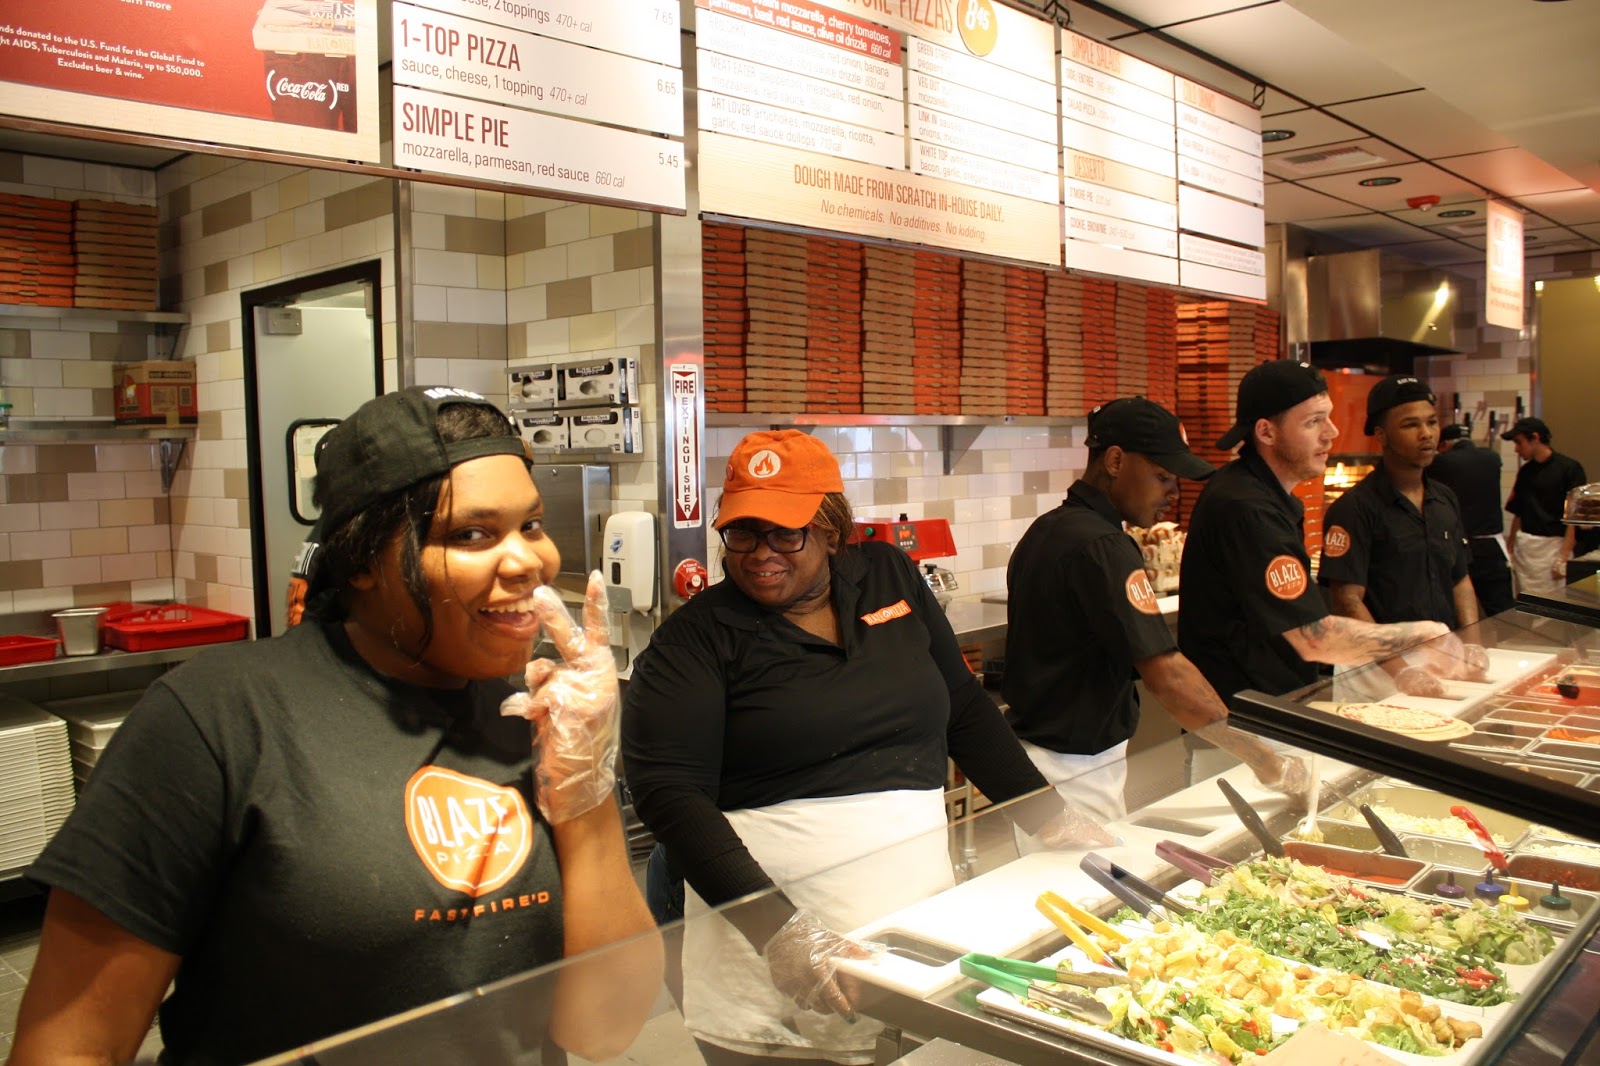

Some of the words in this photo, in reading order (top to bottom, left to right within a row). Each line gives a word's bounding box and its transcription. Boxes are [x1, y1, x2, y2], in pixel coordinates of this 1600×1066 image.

[145, 0, 172, 11] more
[503, 0, 551, 24] toppings
[555, 13, 579, 30] 470+
[580, 20, 593, 33] cal
[653, 8, 674, 26] 7.65
[754, 5, 776, 26] basil,
[776, 15, 791, 29] red
[791, 20, 817, 38] sauce,
[817, 27, 835, 41] olive
[835, 31, 845, 45] oil
[845, 35, 868, 51] drizzle
[870, 43, 883, 56] 660
[883, 48, 892, 58] cal
[780, 2, 827, 26] mozzarella,
[828, 15, 854, 36] cherry
[855, 24, 891, 47] tomatoes,
[0, 35, 10, 47] ht
[12, 38, 40, 53] AIDS,
[42, 43, 93, 60] Tuberculosis
[95, 54, 109, 63] and
[111, 56, 143, 70] Malaria,
[145, 63, 155, 72] up
[156, 64, 165, 72] to
[166, 64, 203, 78] $50,000.
[16, 27, 51, 41] donated
[53, 35, 63, 43] to
[64, 36, 78, 46] the
[80, 38, 98, 49] U.S.
[100, 41, 121, 53] Fund
[122, 45, 135, 55] for
[135, 48, 149, 58] the
[150, 50, 175, 62] Global
[176, 55, 196, 66] Fund
[197, 58, 205, 67] to
[467, 33, 521, 72] PIZZA
[917, 41, 934, 57] GREEN
[57, 58, 94, 72] Excludes
[96, 63, 114, 75] beer
[115, 67, 123, 76] &
[124, 69, 144, 80] wine.
[401, 58, 443, 79] sauce,
[445, 65, 491, 89] cheese,
[493, 74, 499, 89] 1
[502, 77, 544, 101] topping
[549, 86, 573, 104] 470+
[574, 92, 588, 106] cal
[657, 78, 677, 96] 6.65
[864, 59, 889, 77] banana
[336, 82, 350, 93] RED
[847, 92, 861, 106] red
[862, 97, 885, 112] onion,
[402, 102, 475, 143] SIMPLE
[481, 116, 509, 148] PIE
[711, 96, 726, 112] ART
[728, 101, 751, 117] LOVER
[848, 129, 876, 147] ricotta,
[402, 142, 473, 167] mozzarella,
[474, 152, 535, 177] parmesan,
[536, 162, 556, 178] red
[557, 168, 590, 183] sauce
[595, 171, 612, 188] 660
[612, 176, 626, 189] cal
[658, 151, 679, 169] 5.45
[920, 144, 937, 160] WHITE
[938, 148, 949, 161] TOP
[920, 158, 942, 175] bacon,
[1073, 154, 1106, 182] DESSERTS
[794, 163, 831, 190] DOUGH
[834, 171, 864, 197] MADE
[866, 178, 894, 202] FROM
[896, 184, 936, 210] SCRATCH
[939, 192, 978, 218] IN-HOUSE
[980, 201, 1004, 223] DAILY.
[821, 199, 835, 215] No
[837, 203, 885, 224] chemicals.
[889, 210, 902, 226] No
[904, 215, 942, 233] additives.
[945, 221, 957, 235] No
[958, 224, 987, 243] kidding.
[674, 379, 695, 394] FIRE
[681, 396, 692, 512] EXTINGUISHER
[1324, 532, 1347, 547] LAZE
[1270, 563, 1301, 588] BLAZE
[416, 795, 512, 848] BLAZE
[414, 908, 469, 922] FAST
[473, 890, 550, 918] FIRE'D
